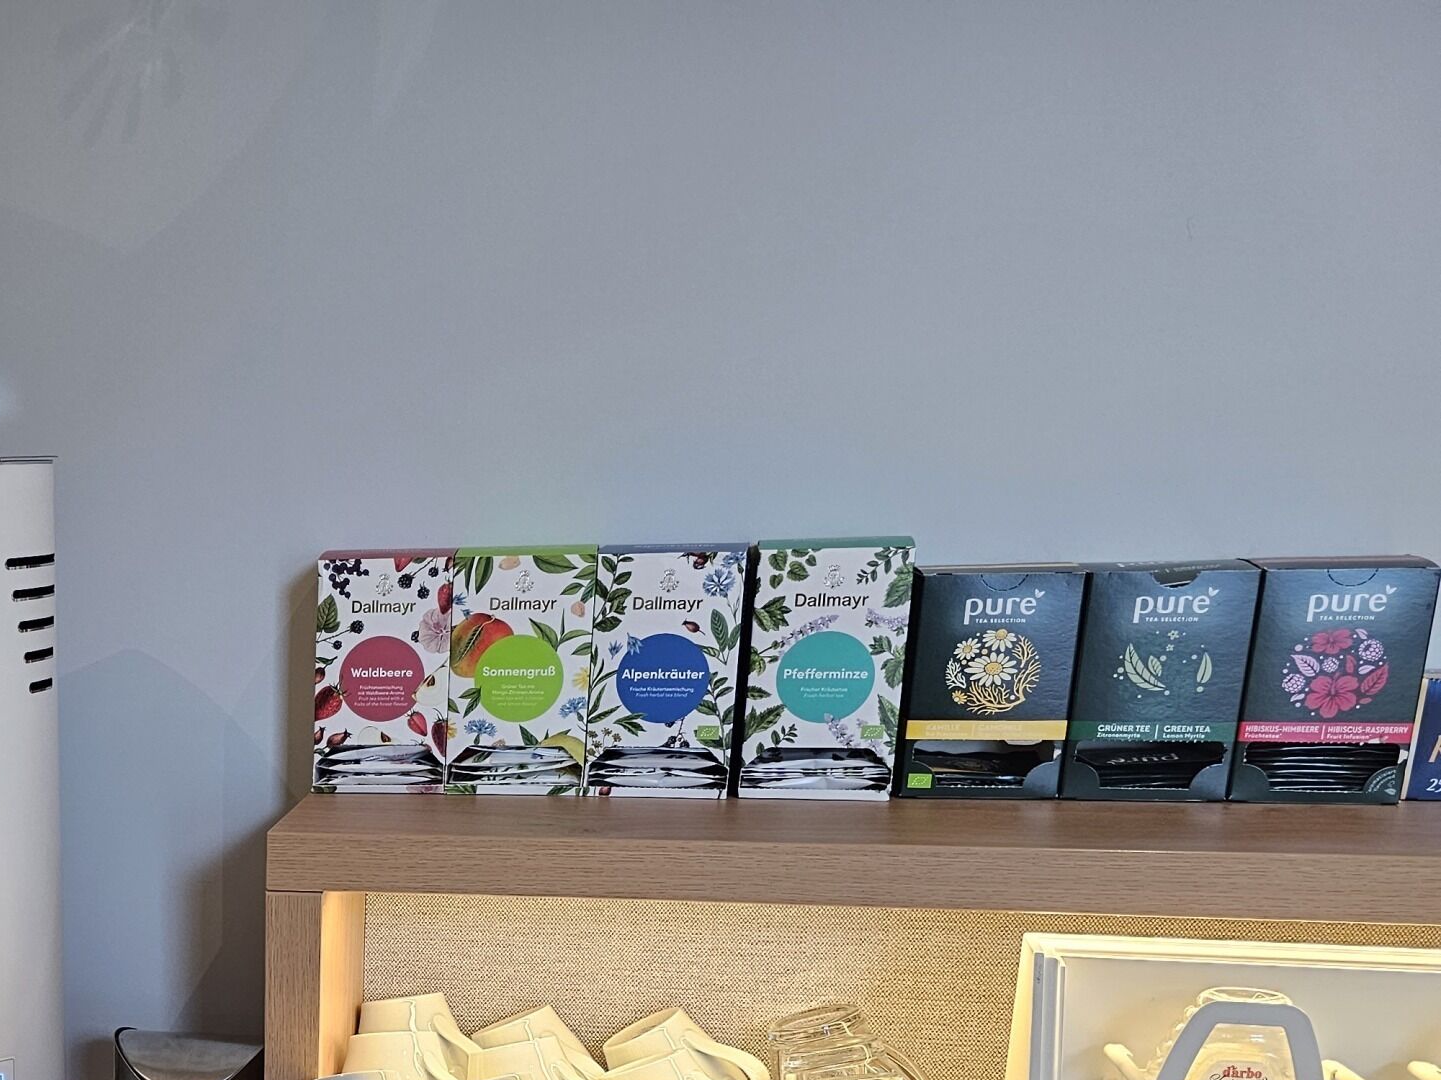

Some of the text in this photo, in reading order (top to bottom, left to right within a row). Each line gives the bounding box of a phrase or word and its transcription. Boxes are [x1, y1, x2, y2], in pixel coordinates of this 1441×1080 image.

[351, 600, 417, 617] Dallmayr
[489, 597, 557, 613] Dallmayr
[632, 596, 703, 614] Dallmayr
[794, 593, 869, 611] Dallmayr
[1132, 595, 1209, 623] pure
[1307, 593, 1387, 622] pure
[964, 597, 1037, 625] pure
[351, 667, 413, 678] Waldbeere
[483, 665, 555, 679] Sonnengruß
[622, 668, 705, 682] Alpenkräuter
[783, 668, 869, 679] Pfefferminze
[1098, 723, 1133, 732] GRÜNER
[1163, 725, 1211, 733] GREEN TEA
[1245, 725, 1320, 733] HIBISKUS-HIMBEERE
[1327, 725, 1409, 734] HIBISCUS-RASPBERRY
